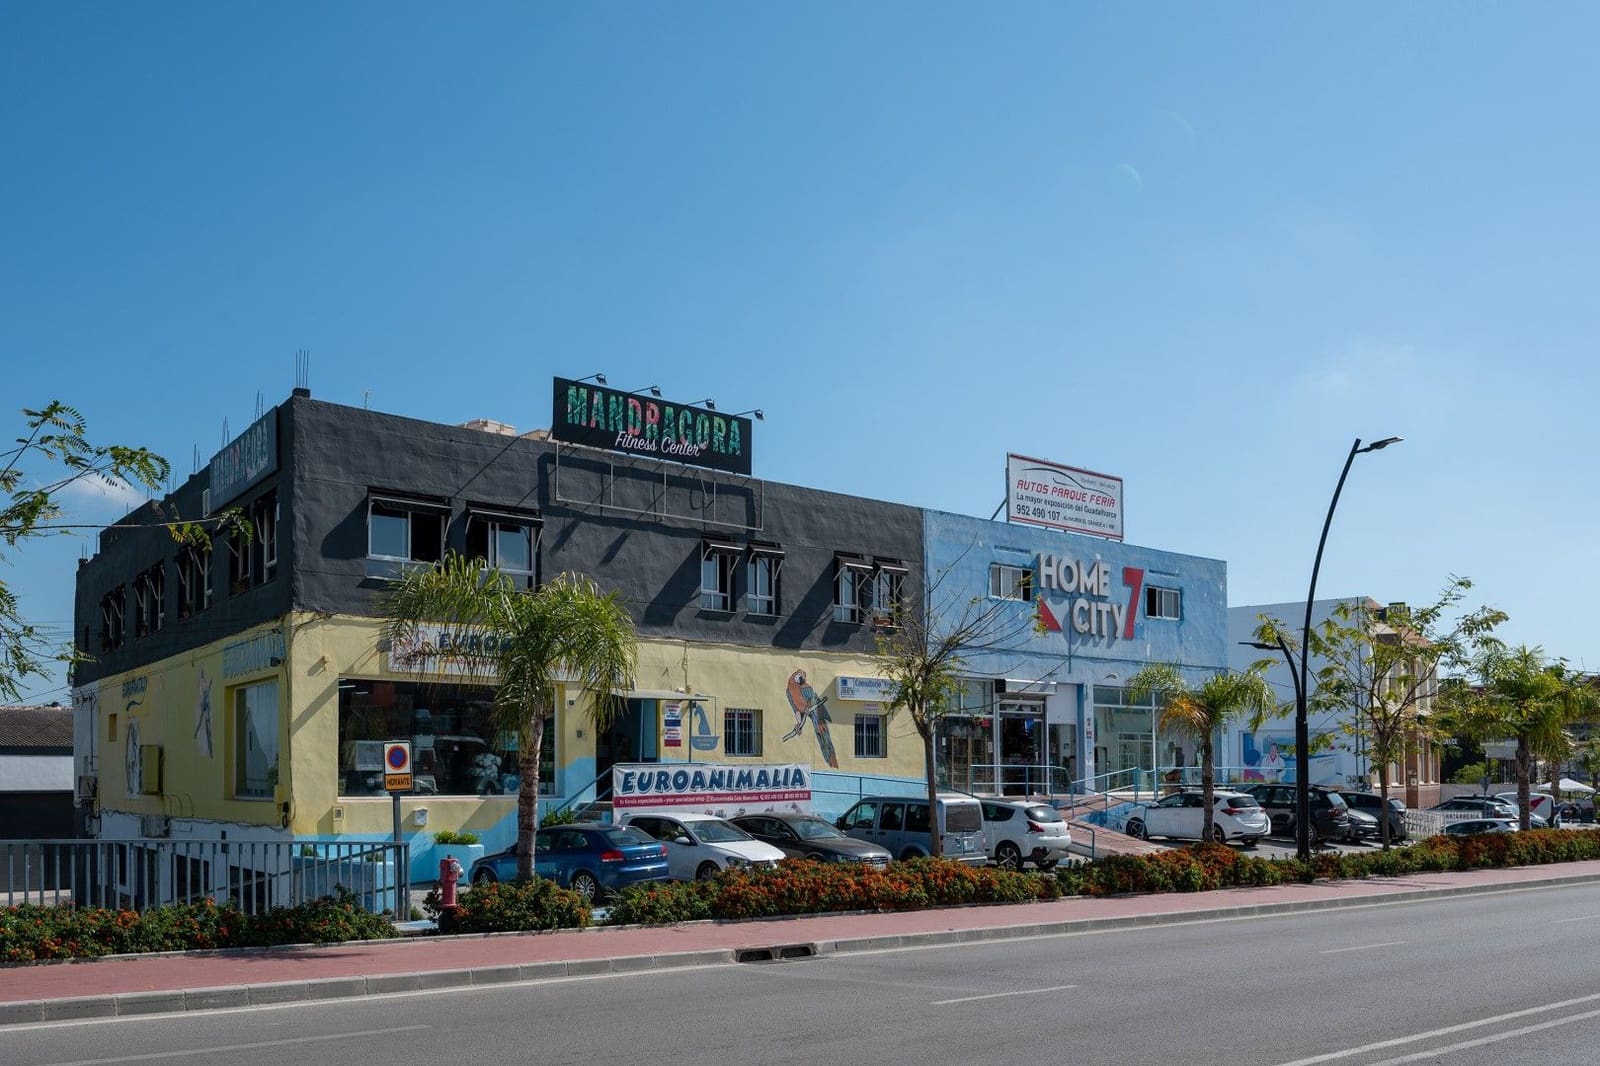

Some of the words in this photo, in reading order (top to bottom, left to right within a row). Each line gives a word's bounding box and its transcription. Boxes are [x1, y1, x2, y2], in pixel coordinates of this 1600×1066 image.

[567, 385, 742, 456] MANDRAGORA
[615, 430, 658, 451] Fitness
[661, 436, 701, 457] Center
[1016, 479, 1049, 495] AUTOS
[1051, 486, 1088, 503] PARQUE
[1090, 494, 1116, 508] FERIA
[1016, 492, 1024, 500] La
[1025, 495, 1043, 505] mayor
[1075, 503, 1083, 512] del
[1084, 505, 1117, 519] Guadalhorce
[1016, 504, 1030, 516] 952
[1032, 507, 1046, 518] 490
[1048, 510, 1061, 521] 107
[1039, 553, 1111, 598] HOME
[1122, 566, 1144, 641] 7
[1072, 598, 1125, 639] CITY
[621, 768, 807, 795] EUROANIMALIA
